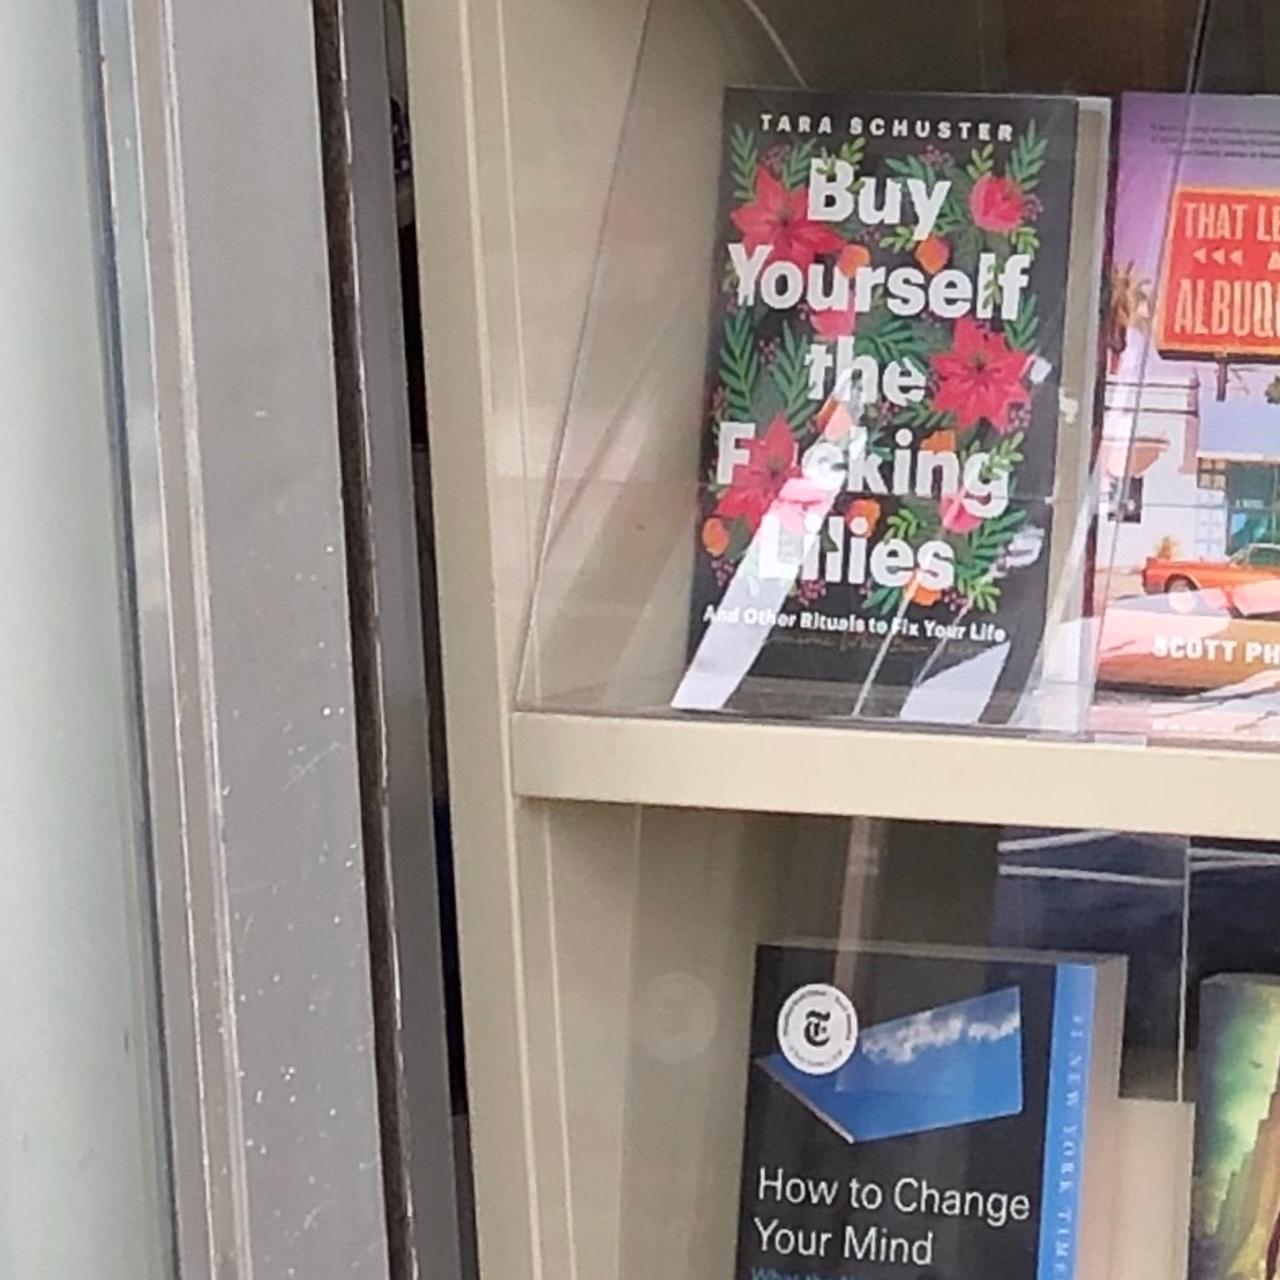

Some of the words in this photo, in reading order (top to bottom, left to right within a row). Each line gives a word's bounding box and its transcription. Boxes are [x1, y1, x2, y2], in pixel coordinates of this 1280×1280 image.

[759, 112, 833, 135] TARA
[849, 116, 1015, 142] SCHUSTER
[806, 157, 952, 242] Buy
[1181, 200, 1250, 244] THAT
[727, 241, 1031, 322] Yourself
[804, 336, 927, 406] the
[716, 421, 1011, 520] Fcking
[756, 512, 958, 592] Lilies
[703, 603, 739, 624] And
[743, 608, 796, 627] Other
[800, 612, 865, 632] Rituals
[869, 617, 887, 634] to
[891, 618, 919, 636] Fix
[923, 619, 966, 639] Your
[970, 621, 1007, 642] Life
[1151, 635, 1237, 663] SCOTT
[1064, 1053, 1081, 1108] NEW
[1059, 1124, 1079, 1192] YORK
[758, 1167, 839, 1206] How
[849, 1180, 883, 1210] to
[893, 1177, 1030, 1228] Change
[753, 1217, 832, 1256] Your
[843, 1225, 934, 1266] Mind
[1049, 1209, 1073, 1280] TIME
